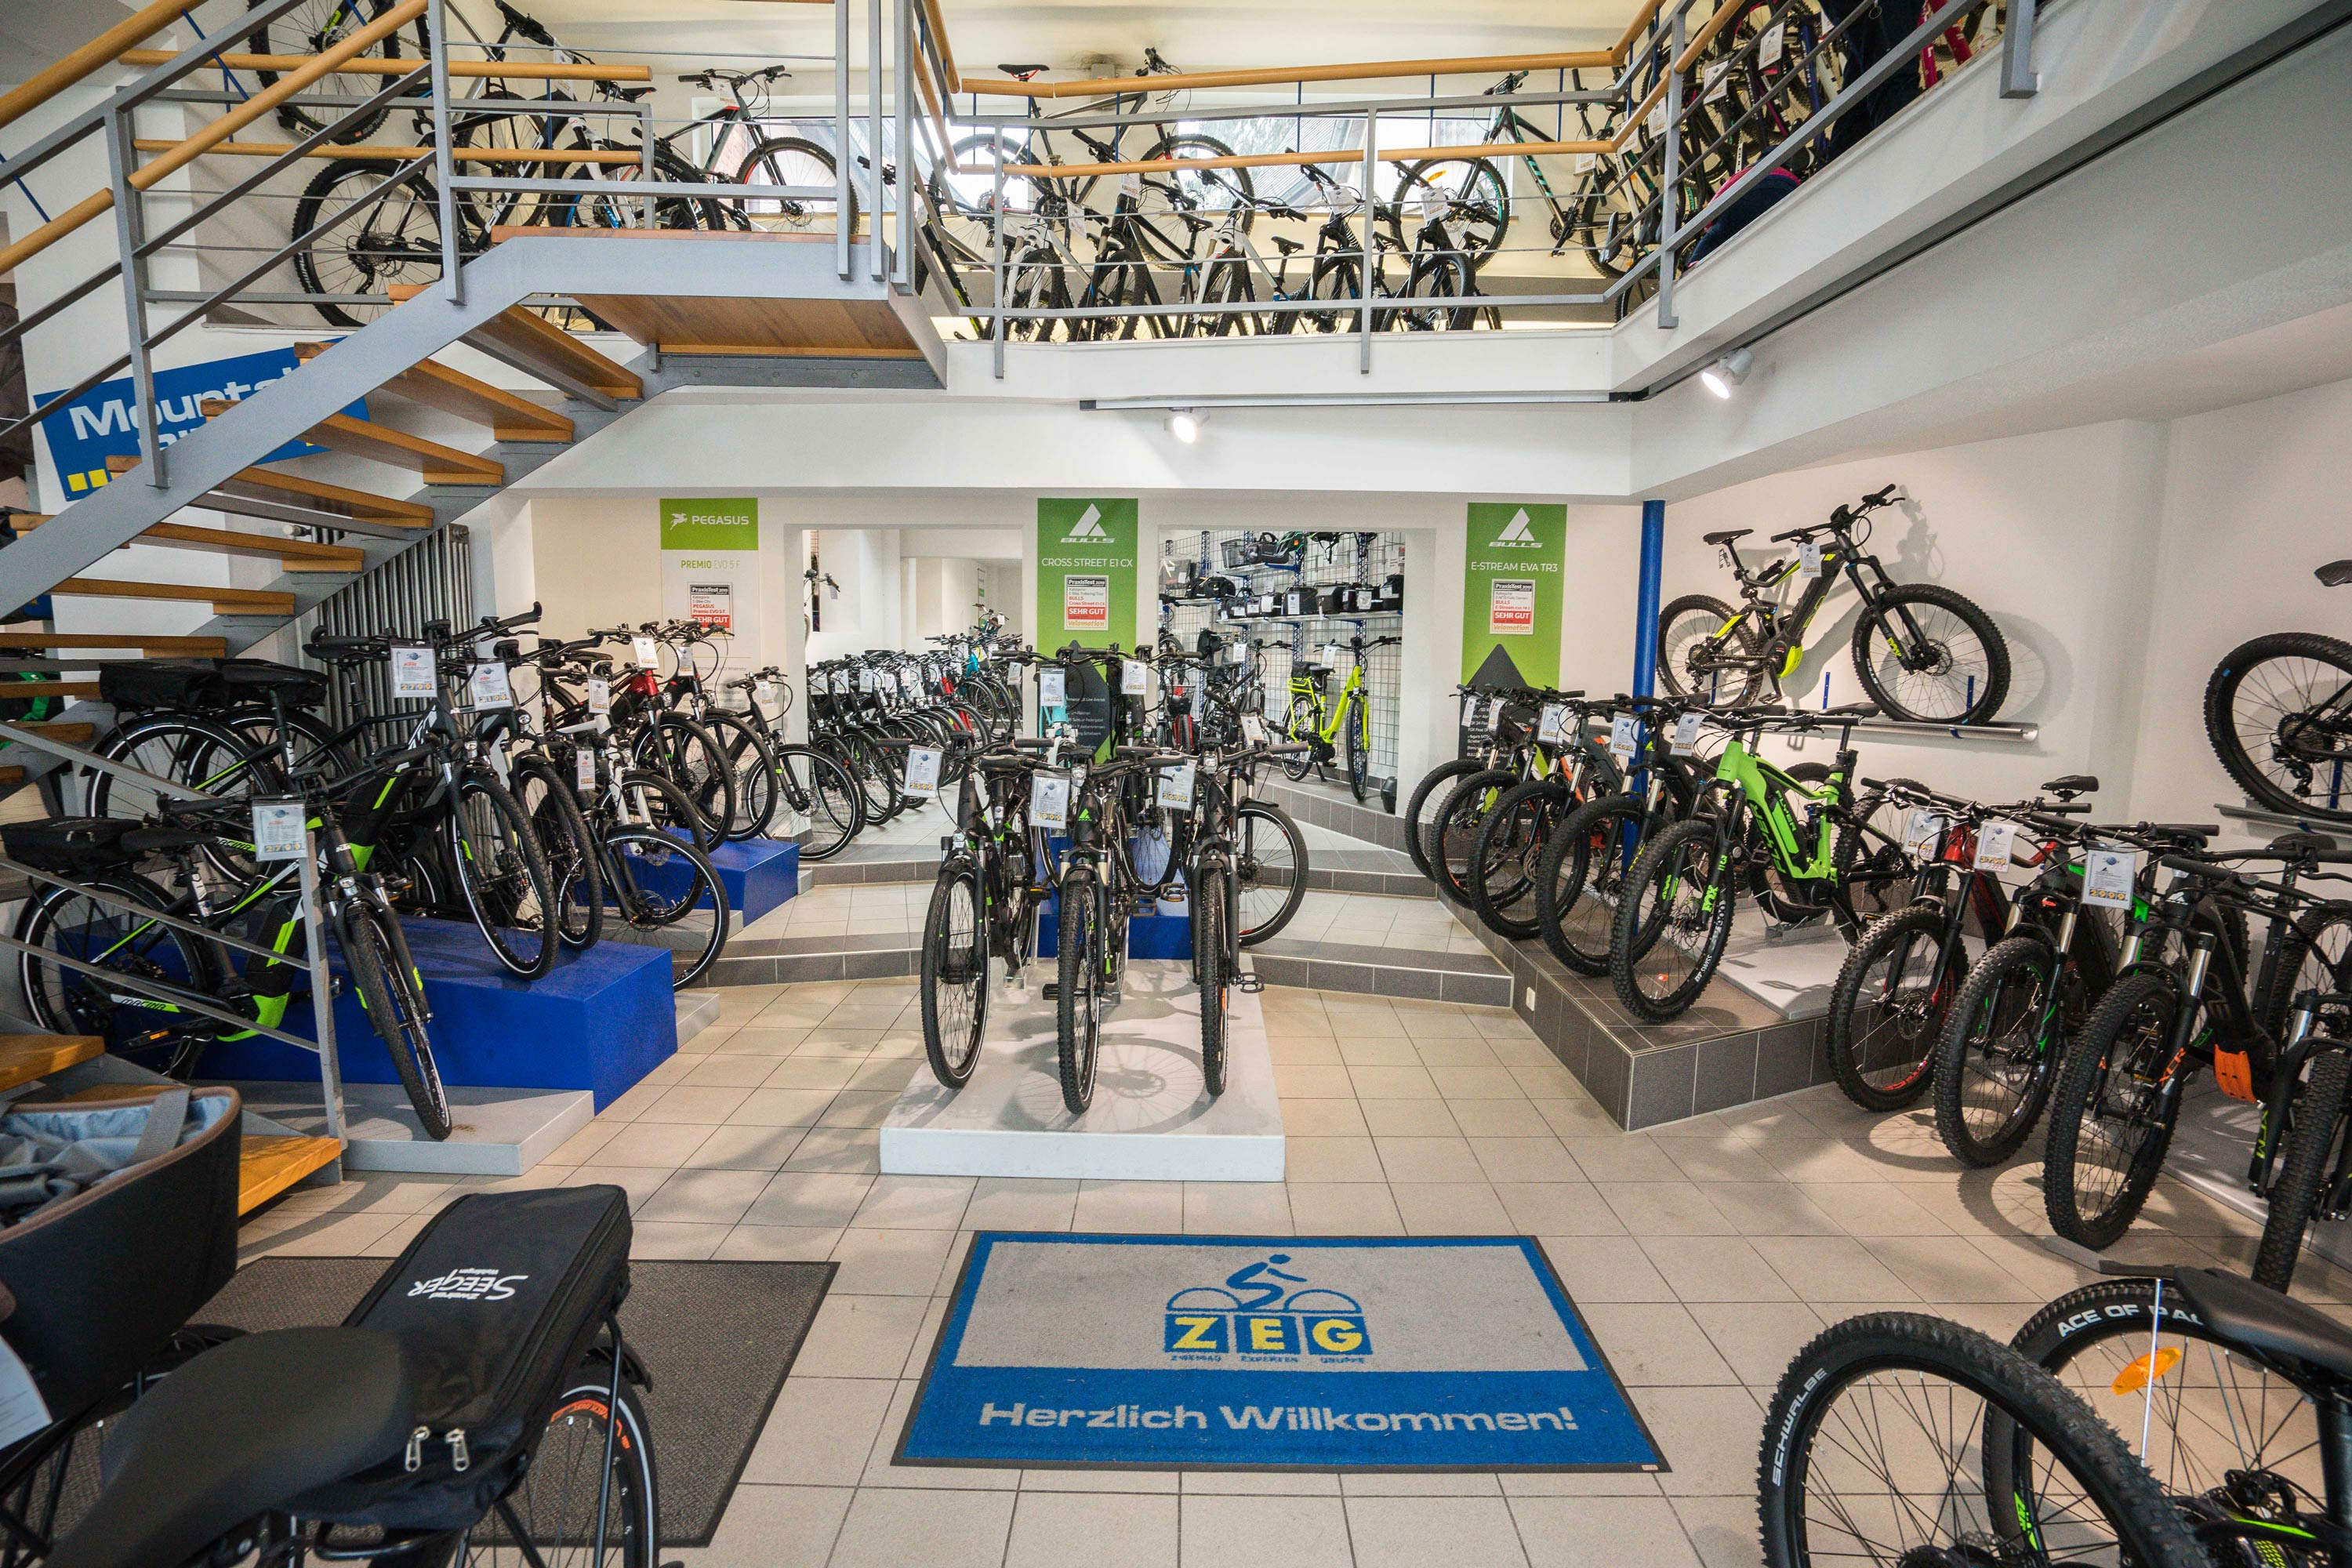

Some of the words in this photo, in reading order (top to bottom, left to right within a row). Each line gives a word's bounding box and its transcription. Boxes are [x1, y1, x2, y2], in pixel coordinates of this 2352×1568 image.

[691, 515, 750, 525] PEGASUS
[681, 560, 712, 569] PREMIO
[1041, 557, 1073, 567] CROSS
[1073, 558, 1108, 567] STREET
[1120, 559, 1134, 568] CX
[1471, 561, 1518, 571] E-STREAM
[1520, 562, 1539, 572] EVA
[1541, 563, 1558, 572] TR3
[1702, 884, 1719, 913] FOX
[2089, 888, 2125, 900] 2999
[407, 1269, 529, 1301] SEEGER
[1172, 1316, 1363, 1352] ZEG
[2057, 1309, 2102, 1338] ACE
[2103, 1304, 2140, 1318] OF
[979, 1403, 1208, 1430] Herzlich
[1218, 1405, 1579, 1432] Willkommen!
[1772, 1367, 1828, 1486] SCHWALBE
